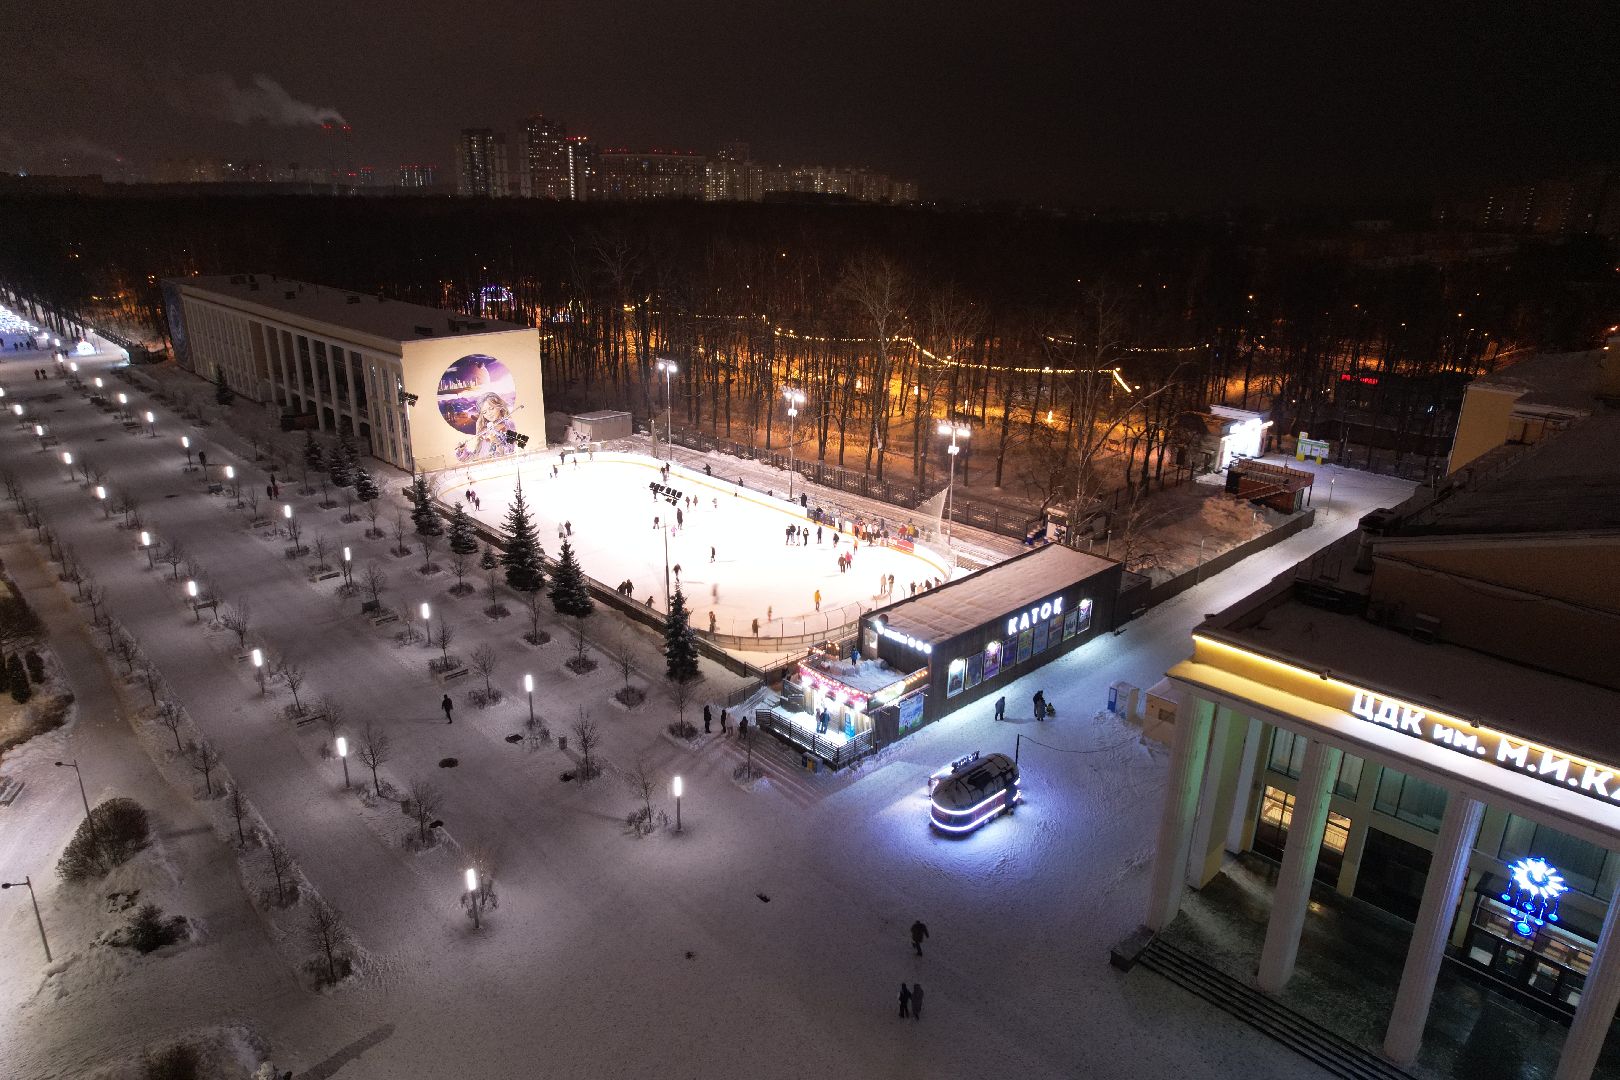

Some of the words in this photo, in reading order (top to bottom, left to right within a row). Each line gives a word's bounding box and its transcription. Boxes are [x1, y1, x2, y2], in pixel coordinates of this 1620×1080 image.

[1008, 596, 1063, 636] КАТОК
[1351, 691, 1425, 736] ЦДК
[1432, 723, 1486, 755] им.
